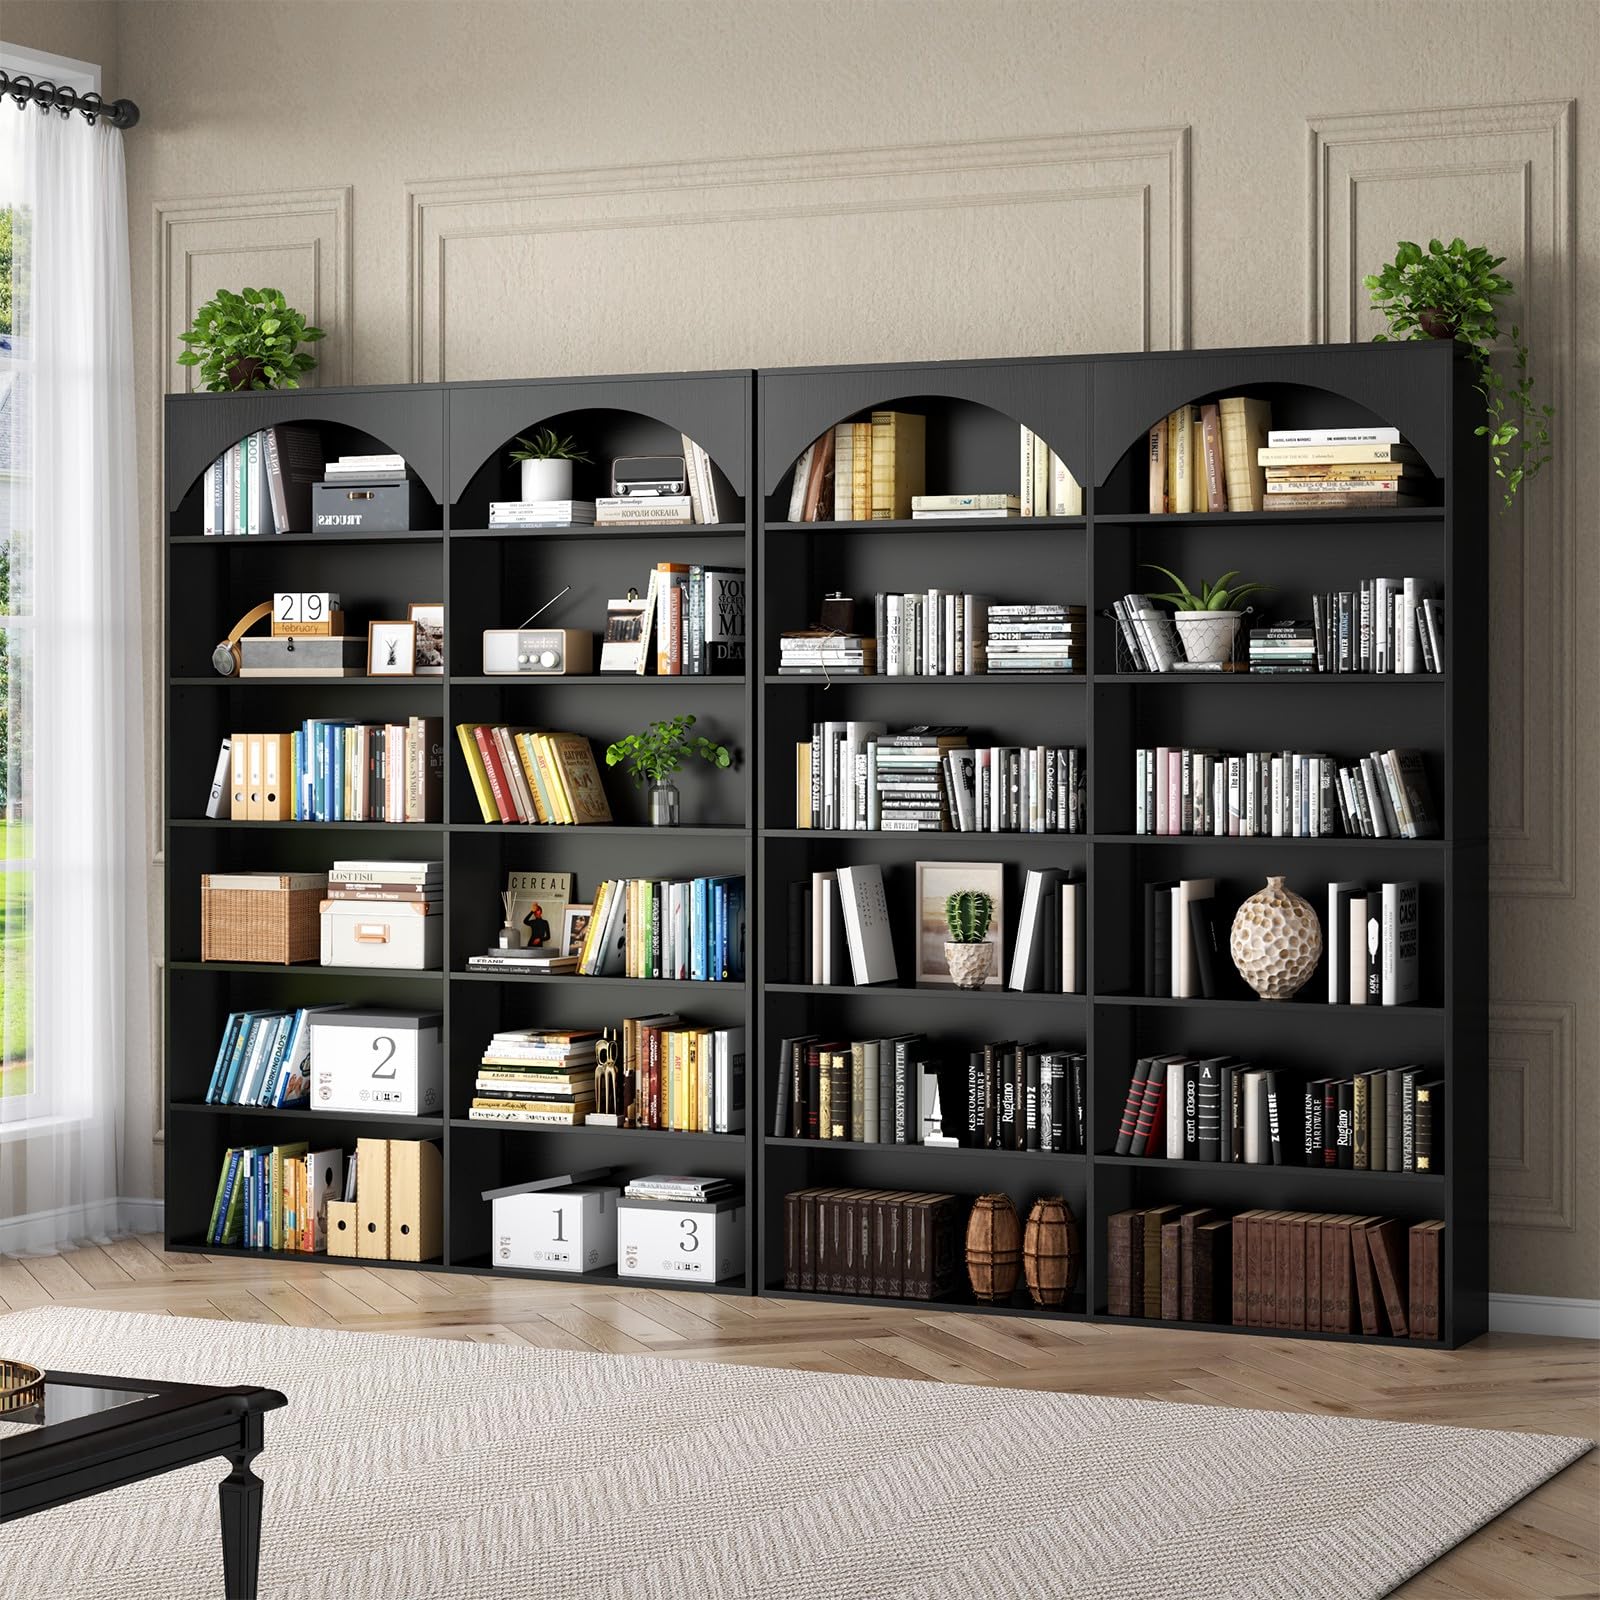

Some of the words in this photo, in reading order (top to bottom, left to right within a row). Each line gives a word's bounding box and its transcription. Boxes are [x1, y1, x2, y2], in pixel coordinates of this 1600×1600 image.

[282, 623, 319, 634] february
[718, 604, 744, 616] WAN
[718, 614, 744, 636] M
[482, 752, 502, 799] ANTIQUAIRES
[520, 746, 530, 768] FINE
[529, 777, 543, 811] WINES
[538, 756, 546, 769] ART
[332, 872, 352, 881] LOST
[354, 872, 373, 881] FISH
[512, 877, 566, 890] CEREAL
[1400, 903, 1416, 924] CASH
[265, 1057, 280, 1093] WORKING
[275, 1034, 287, 1057] DAD'S
[372, 1036, 396, 1079] 2
[896, 1044, 904, 1083] WILLIAM
[1202, 1068, 1211, 1078] A
[1001, 1082, 1015, 1123] Rugiano
[1402, 1074, 1412, 1112] WILLIAM
[896, 1085, 904, 1142] SHAKESPEARE
[1268, 1093, 1279, 1134] GALLERIE
[1313, 1099, 1322, 1148] HARDWARE
[1337, 1110, 1352, 1146] Rugiano
[1402, 1114, 1412, 1169] SHAKESPEARE
[552, 1208, 568, 1242] 1
[680, 1219, 699, 1252] 3
